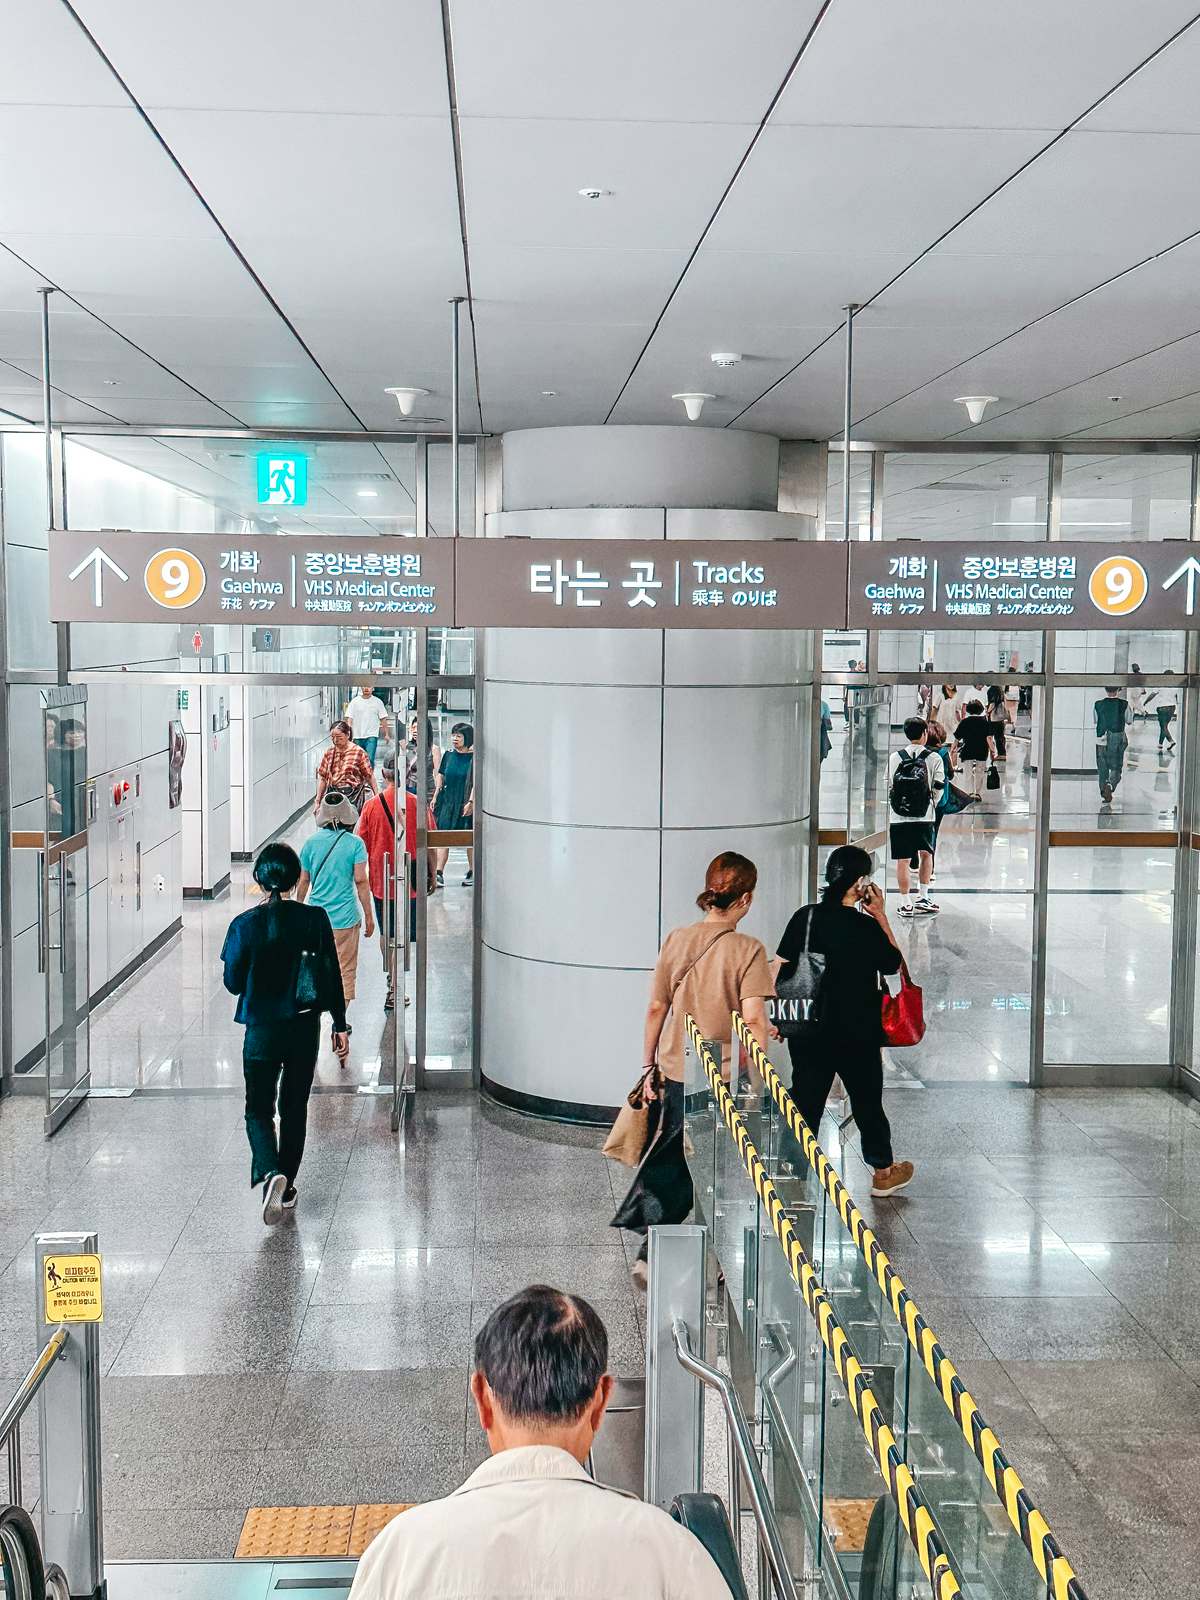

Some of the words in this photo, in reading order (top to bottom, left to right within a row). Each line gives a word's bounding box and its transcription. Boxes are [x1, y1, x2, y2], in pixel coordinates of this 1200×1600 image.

[219, 550, 262, 574] 개화
[304, 552, 422, 577] 중앙보훈병원
[692, 560, 765, 584] Tracks
[888, 556, 928, 579] 개화
[962, 556, 1077, 580] 중앙보훈병원
[160, 559, 190, 597] 9
[220, 577, 284, 595] Gaehwa
[303, 579, 333, 596] VHS
[335, 580, 388, 597] Medical
[390, 582, 436, 598] Center
[529, 558, 609, 608] 타는
[621, 560, 663, 609] 곳
[1104, 566, 1133, 606] 9
[732, 590, 777, 607] のりば
[864, 582, 925, 599] Gaehwa
[944, 583, 973, 599] VHS
[975, 583, 1027, 599] Medical
[1029, 583, 1075, 599] Center
